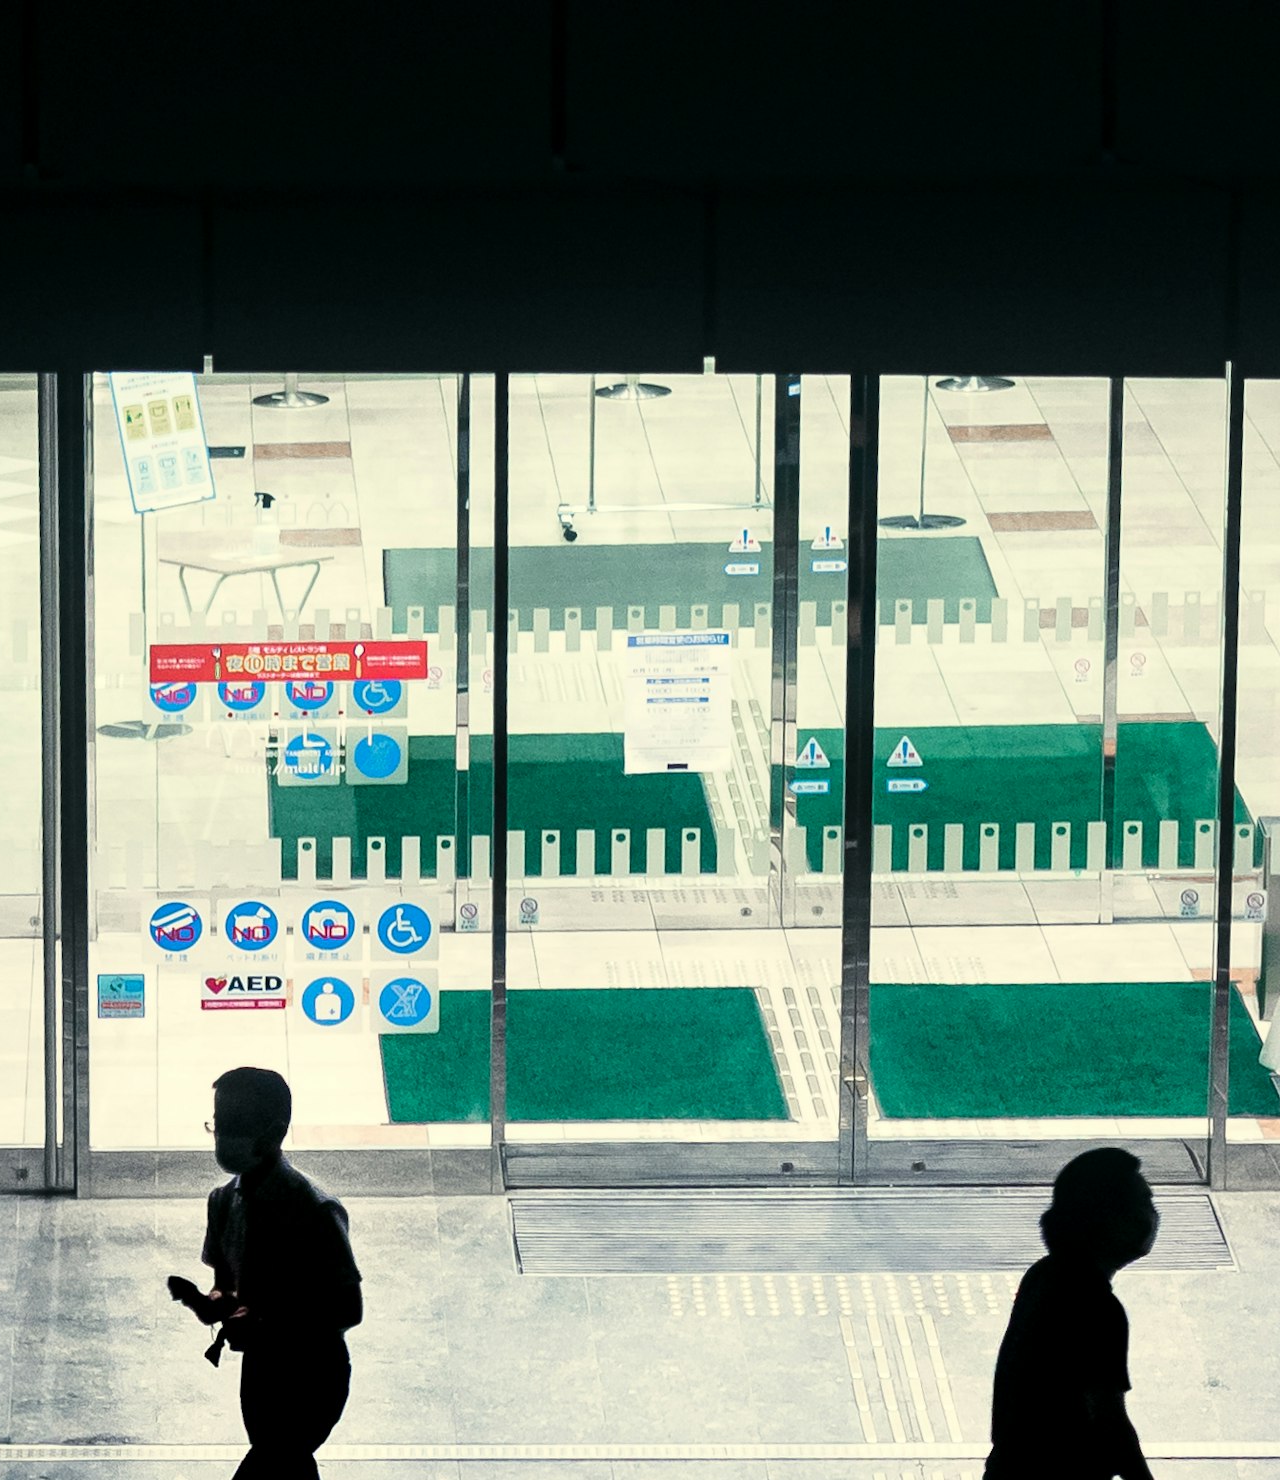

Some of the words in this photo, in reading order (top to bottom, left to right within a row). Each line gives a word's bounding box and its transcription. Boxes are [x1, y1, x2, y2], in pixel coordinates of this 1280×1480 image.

[155, 688, 189, 703] NO
[224, 687, 258, 702] NO
[292, 686, 326, 700] NO
[156, 926, 195, 942] NO
[232, 925, 270, 941] NO
[309, 925, 347, 939] NO
[228, 975, 283, 992] AED
